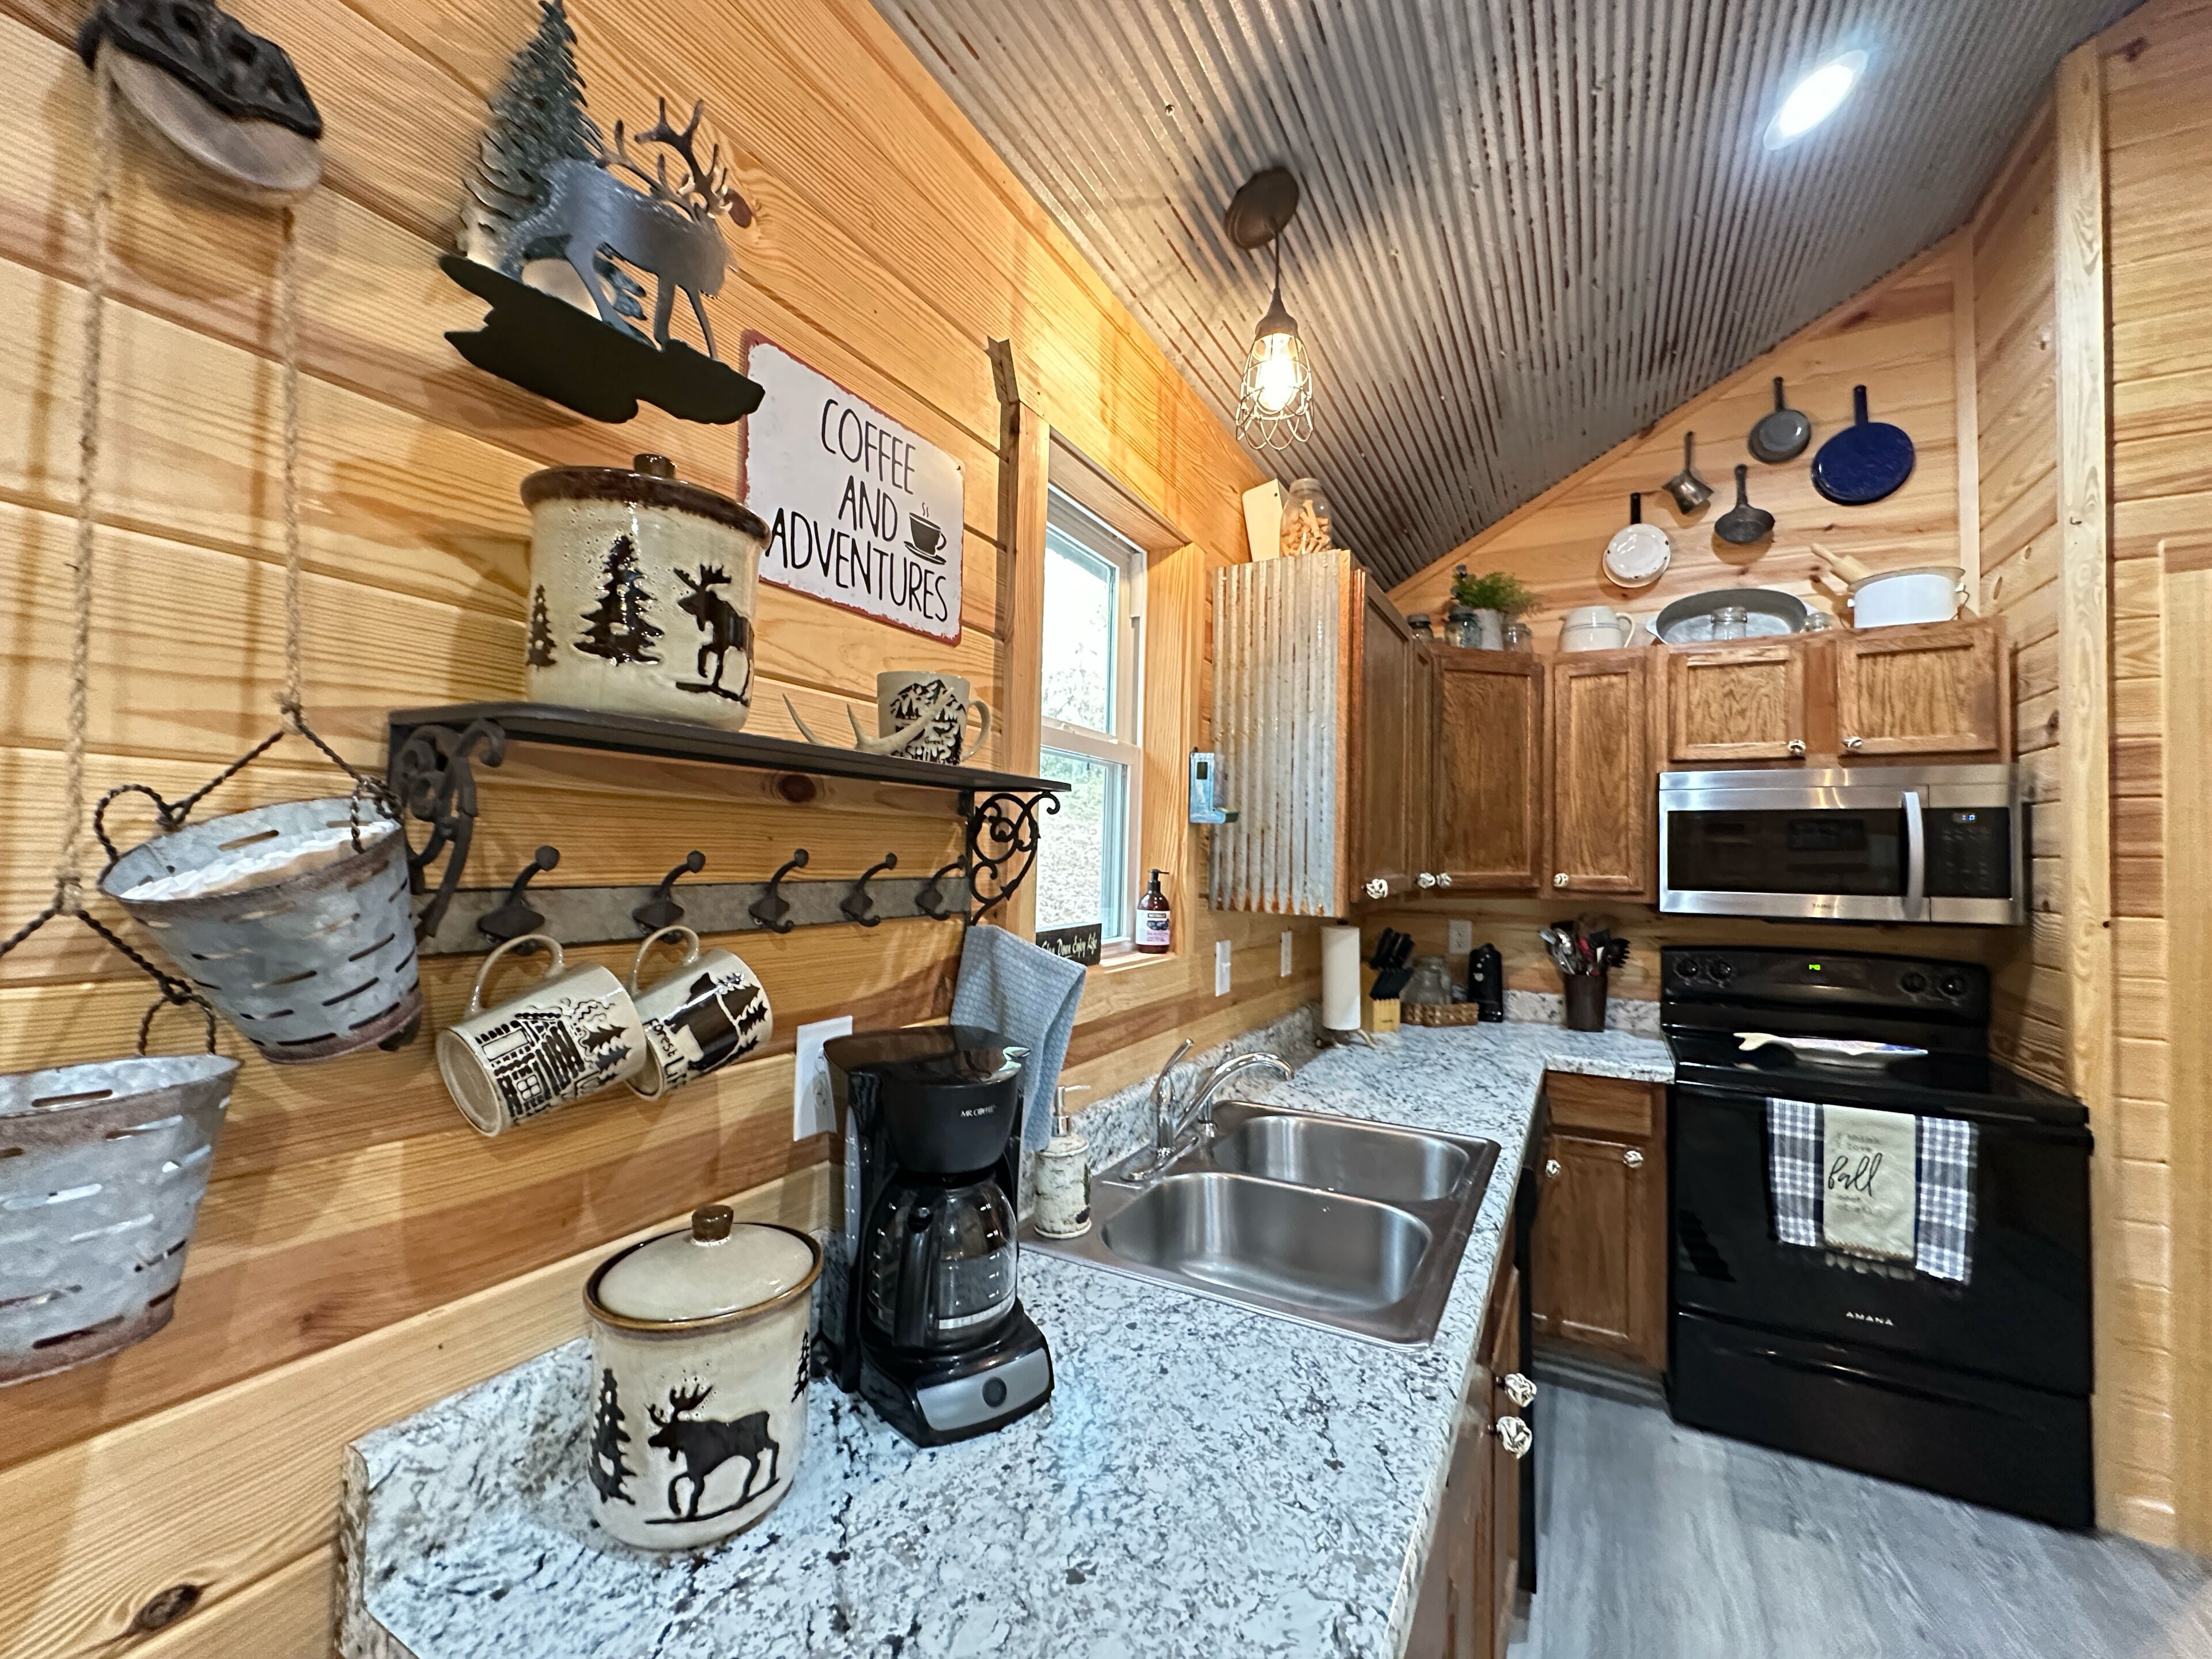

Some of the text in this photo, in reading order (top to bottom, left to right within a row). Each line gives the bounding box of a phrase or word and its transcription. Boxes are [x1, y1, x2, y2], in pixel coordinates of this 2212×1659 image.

[821, 399, 916, 495] COFFEE
[838, 475, 898, 541] AND
[766, 507, 948, 622] ADVENTURES
[1846, 1311, 1894, 1326] AMANA
